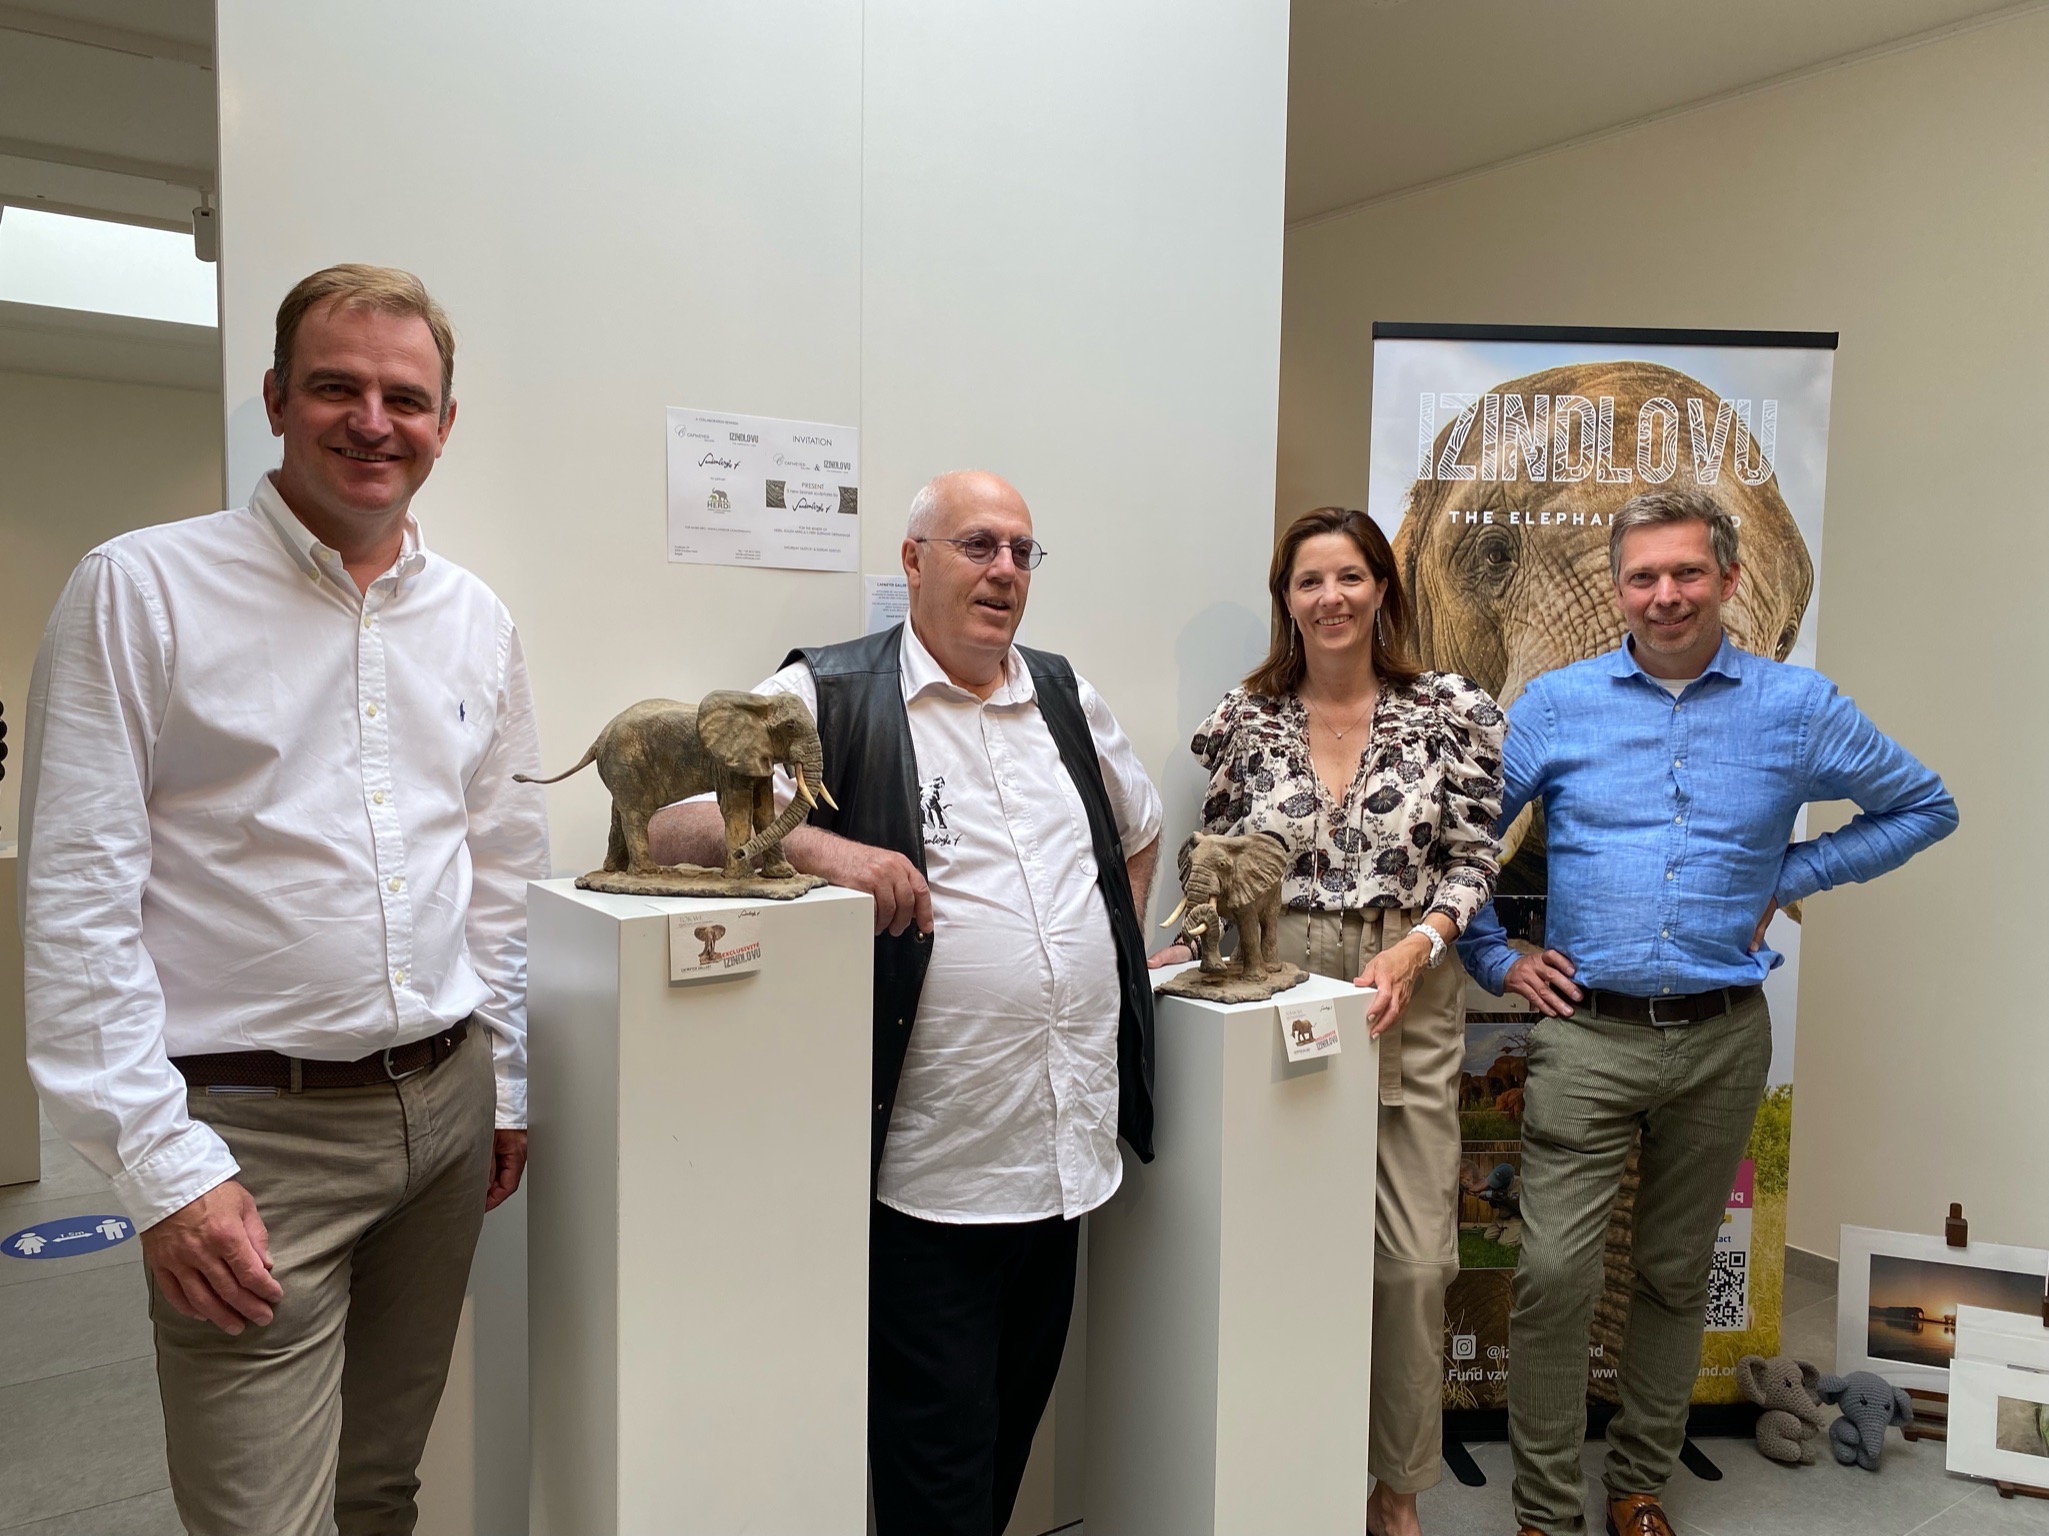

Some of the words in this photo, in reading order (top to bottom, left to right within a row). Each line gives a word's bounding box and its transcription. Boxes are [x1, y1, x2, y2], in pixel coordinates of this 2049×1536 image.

[729, 432, 759, 443] IZINDLOVU
[792, 435, 832, 447] INVITATION
[1417, 392, 1778, 486] IZINDLOVU
[823, 460, 851, 471] IZINDLOVU
[801, 482, 825, 490] PRESENT
[1449, 511, 1494, 524] THE
[1510, 512, 1614, 526] ELEPHA
[723, 948, 761, 969] IZINDLOVU
[1448, 1369, 1483, 1380] Fund
